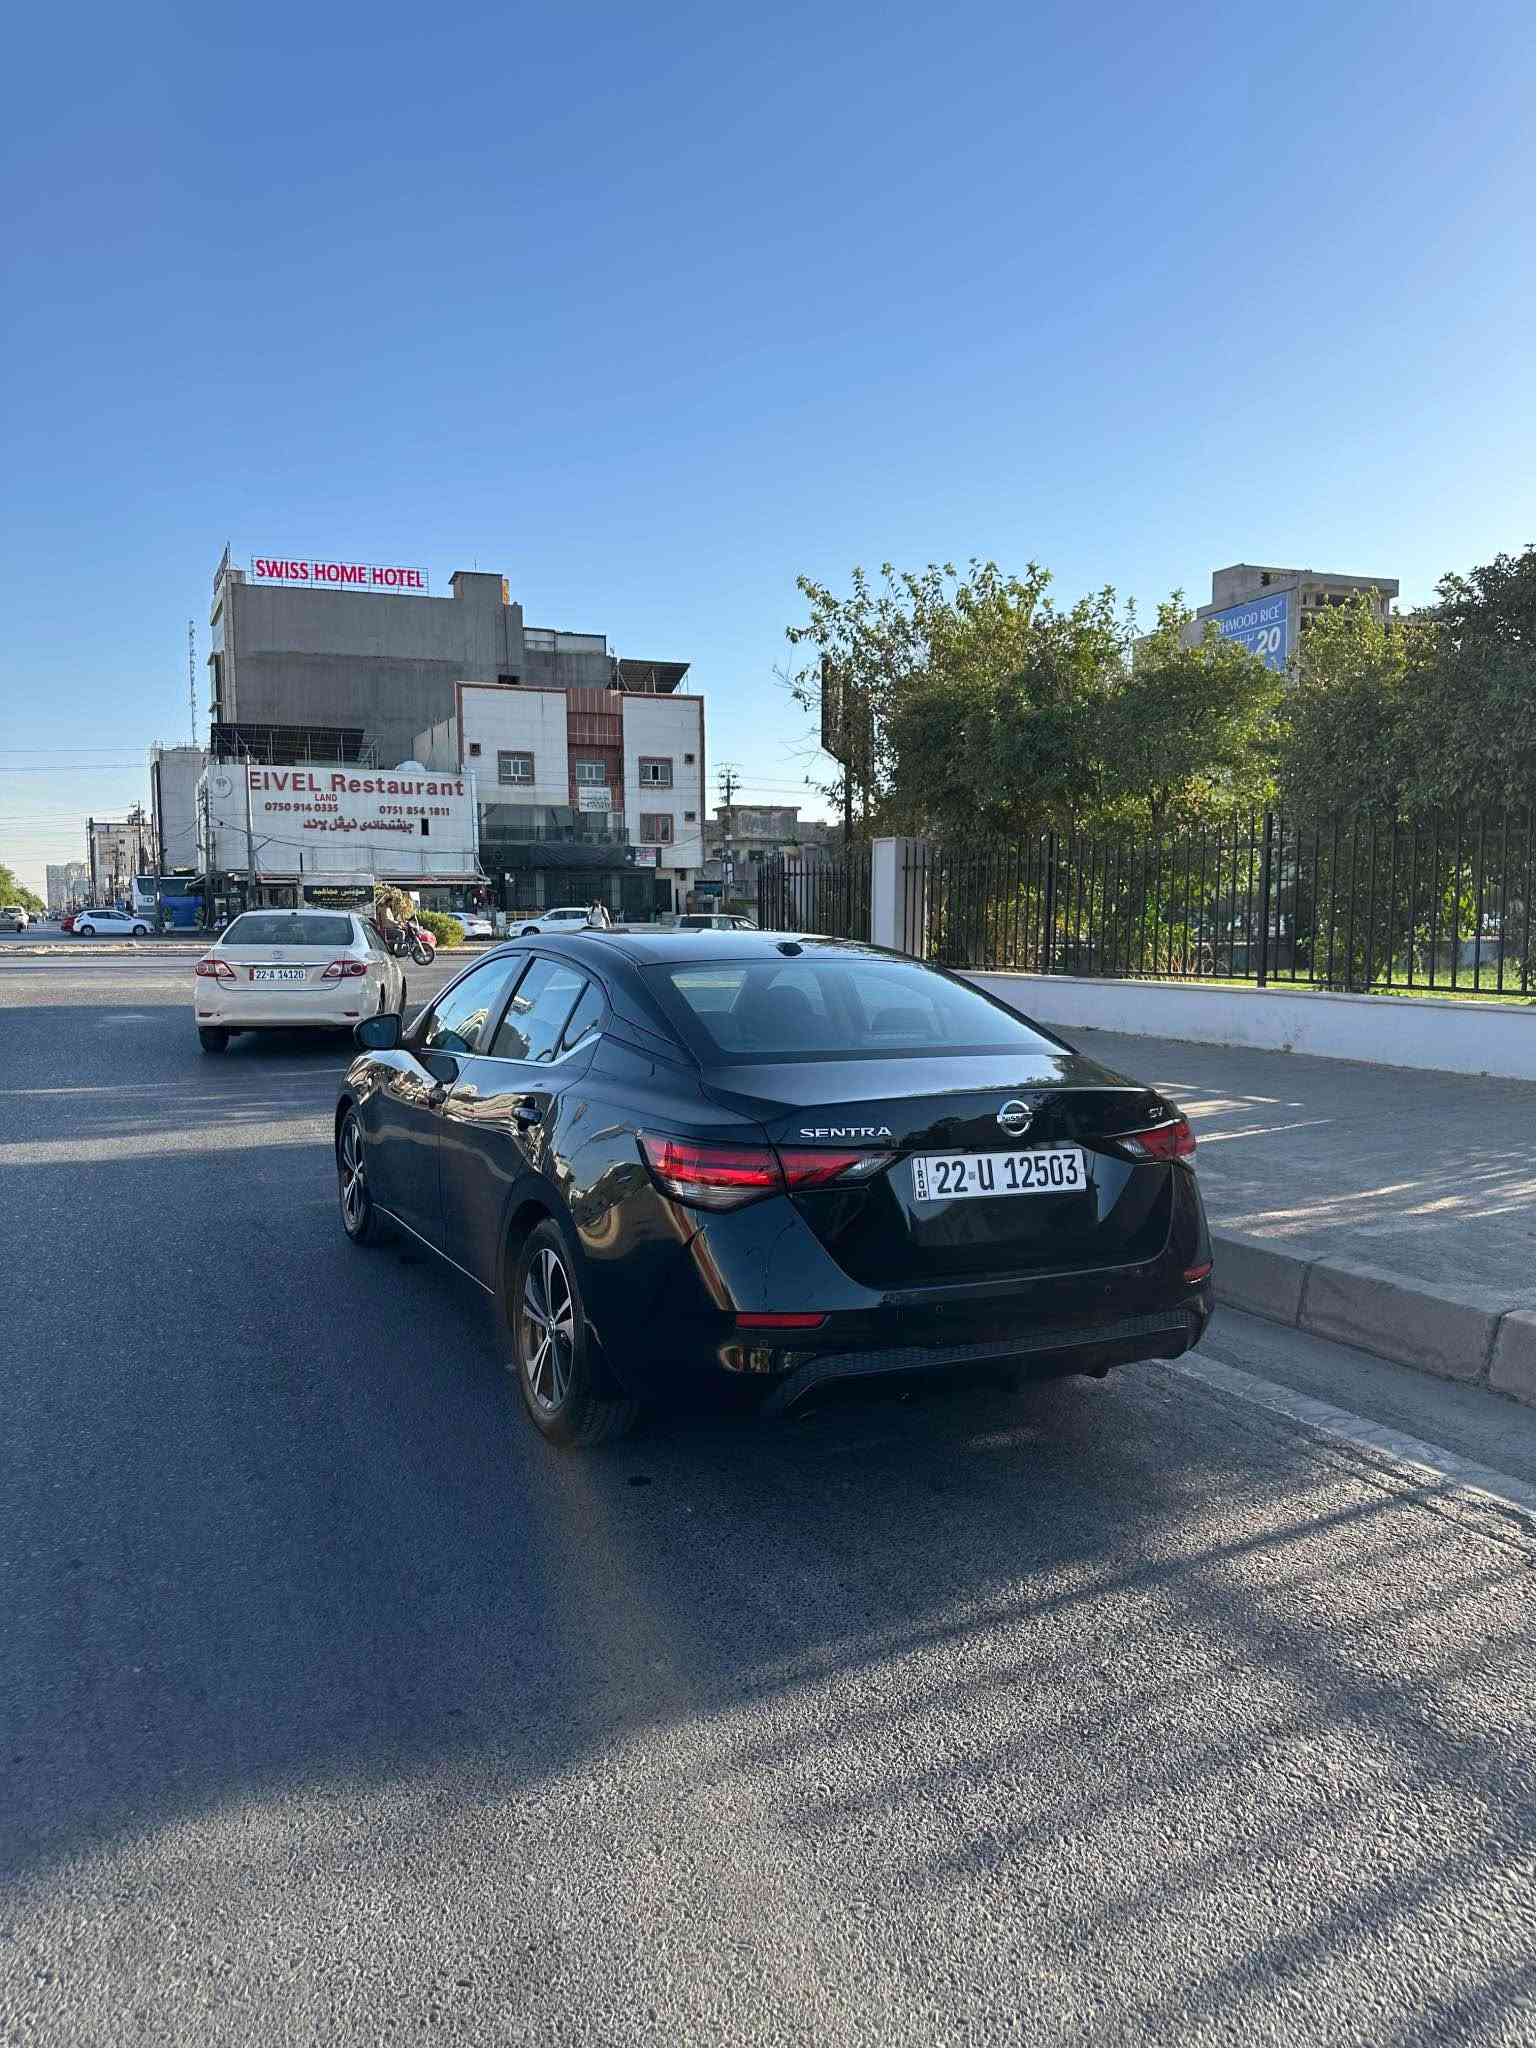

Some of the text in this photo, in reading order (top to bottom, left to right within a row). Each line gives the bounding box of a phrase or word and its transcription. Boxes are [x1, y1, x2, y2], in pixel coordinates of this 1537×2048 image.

[255, 559, 424, 588] SWISS HOME HOTEL
[1260, 606, 1280, 623] RICE
[1255, 626, 1281, 654] 20
[331, 773, 464, 796] Restaurant
[314, 793, 338, 802] LAND
[264, 802, 291, 812] 0750
[293, 803, 313, 812] 914
[379, 805, 403, 815] 0751
[799, 1124, 893, 1138] SENTRA
[935, 1154, 1079, 1194] 22 U 12503
